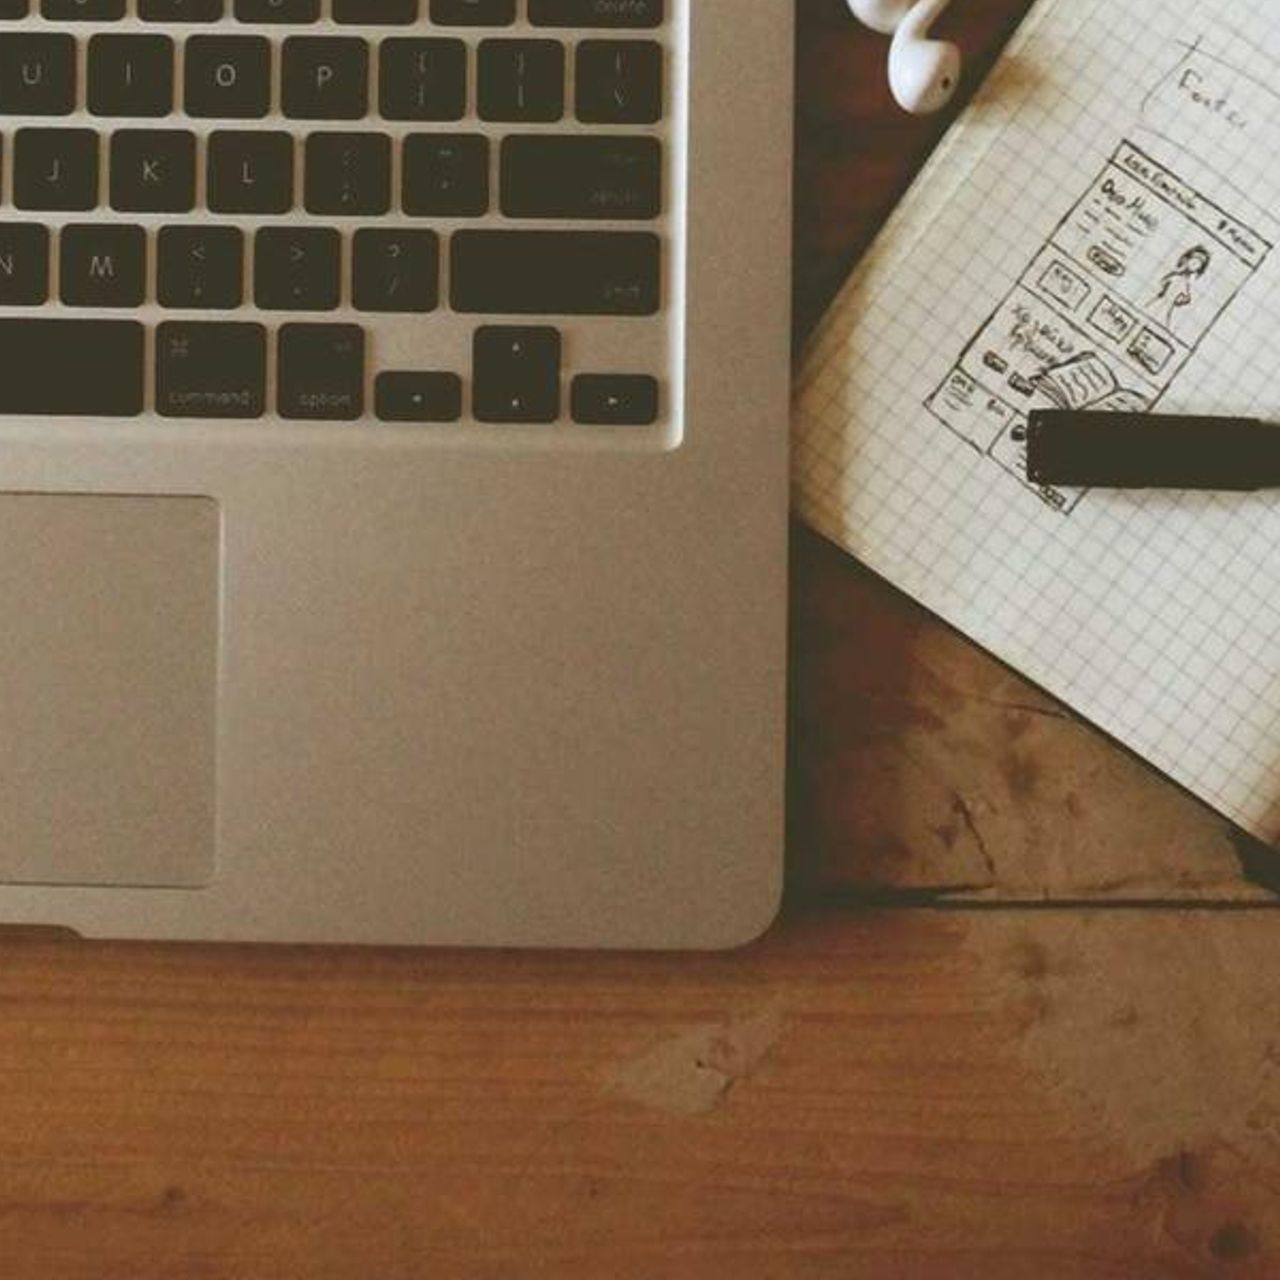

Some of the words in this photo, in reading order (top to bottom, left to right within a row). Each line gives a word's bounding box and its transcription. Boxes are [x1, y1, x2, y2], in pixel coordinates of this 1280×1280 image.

[22, 63, 42, 85] U
[317, 65, 333, 87] P
[47, 159, 60, 182] J
[143, 161, 158, 181] K
[242, 162, 255, 184] L
[89, 255, 113, 277] M
